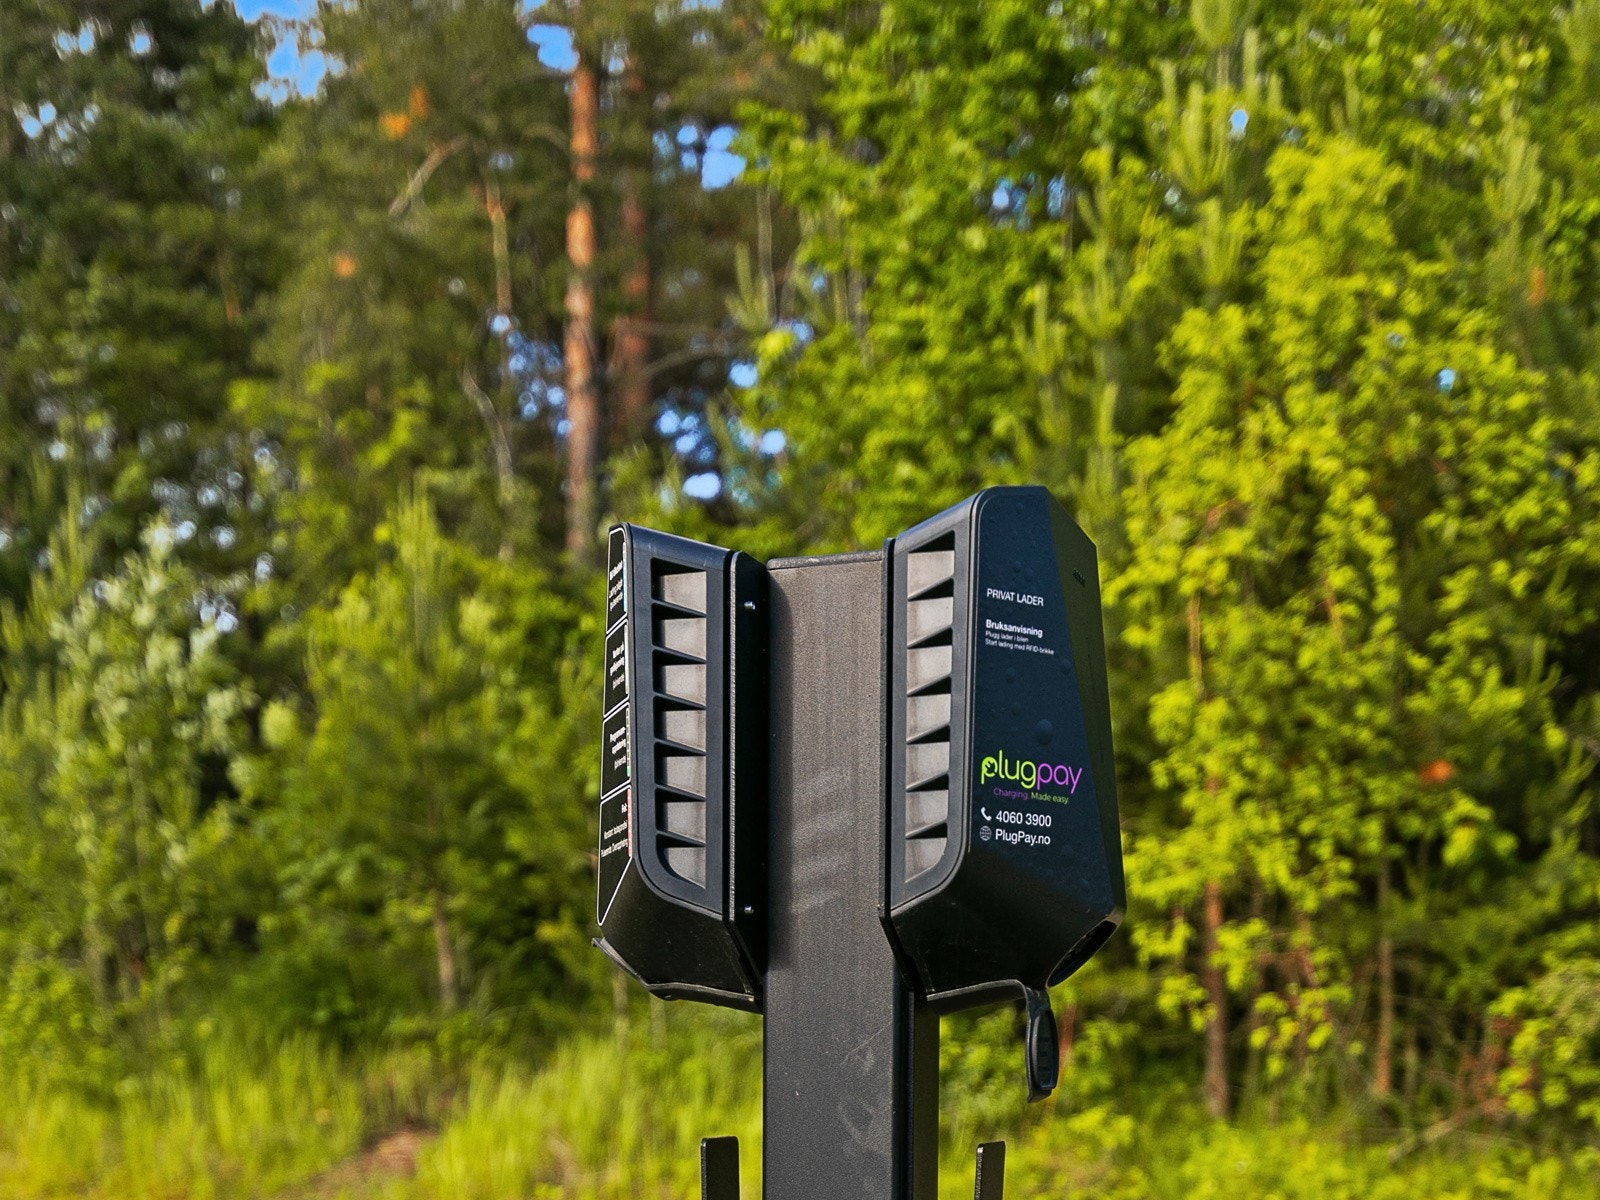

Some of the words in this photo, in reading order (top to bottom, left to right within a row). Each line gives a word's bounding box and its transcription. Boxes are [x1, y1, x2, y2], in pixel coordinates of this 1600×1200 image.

[986, 588, 1015, 601] PRIVAT
[1016, 593, 1044, 607] LADER
[985, 619, 1043, 639] Bruksanvisning
[980, 749, 1083, 795] plugpay
[1030, 791, 1051, 802] Made
[1052, 795, 1069, 805] easy
[995, 810, 1023, 825] 4060
[1025, 812, 1052, 827] 3900
[995, 828, 1051, 846] PlugPay.no
